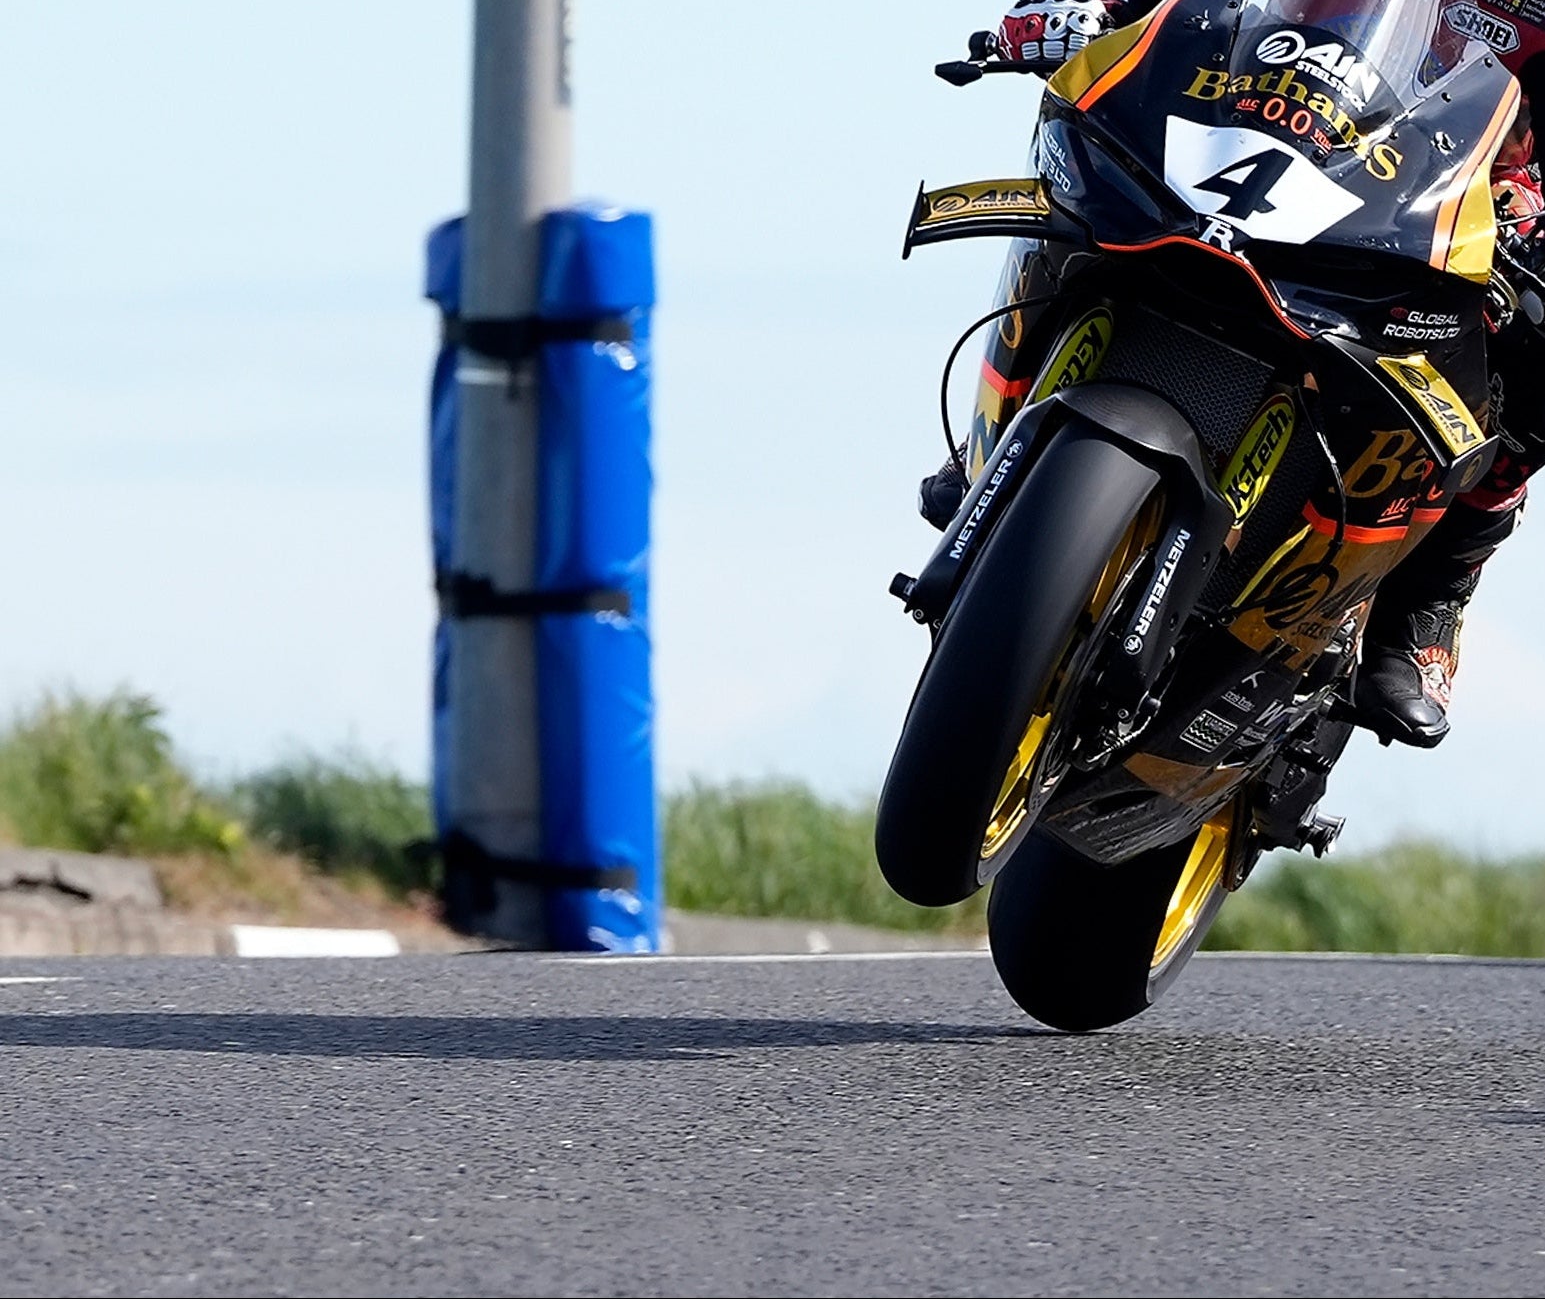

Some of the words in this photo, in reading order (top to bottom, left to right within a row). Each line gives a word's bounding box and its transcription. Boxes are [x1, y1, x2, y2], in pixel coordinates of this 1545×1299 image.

[1295, 60, 1366, 113] STEELSTOCK
[1302, 42, 1381, 105] AJN
[1262, 97, 1312, 135] 0.0
[1193, 148, 1295, 221] 4
[1406, 310, 1462, 326] GLOBAL
[1426, 393, 1478, 445] AJN
[949, 457, 1014, 560] METZELER
[1135, 527, 1192, 637] METZELER
